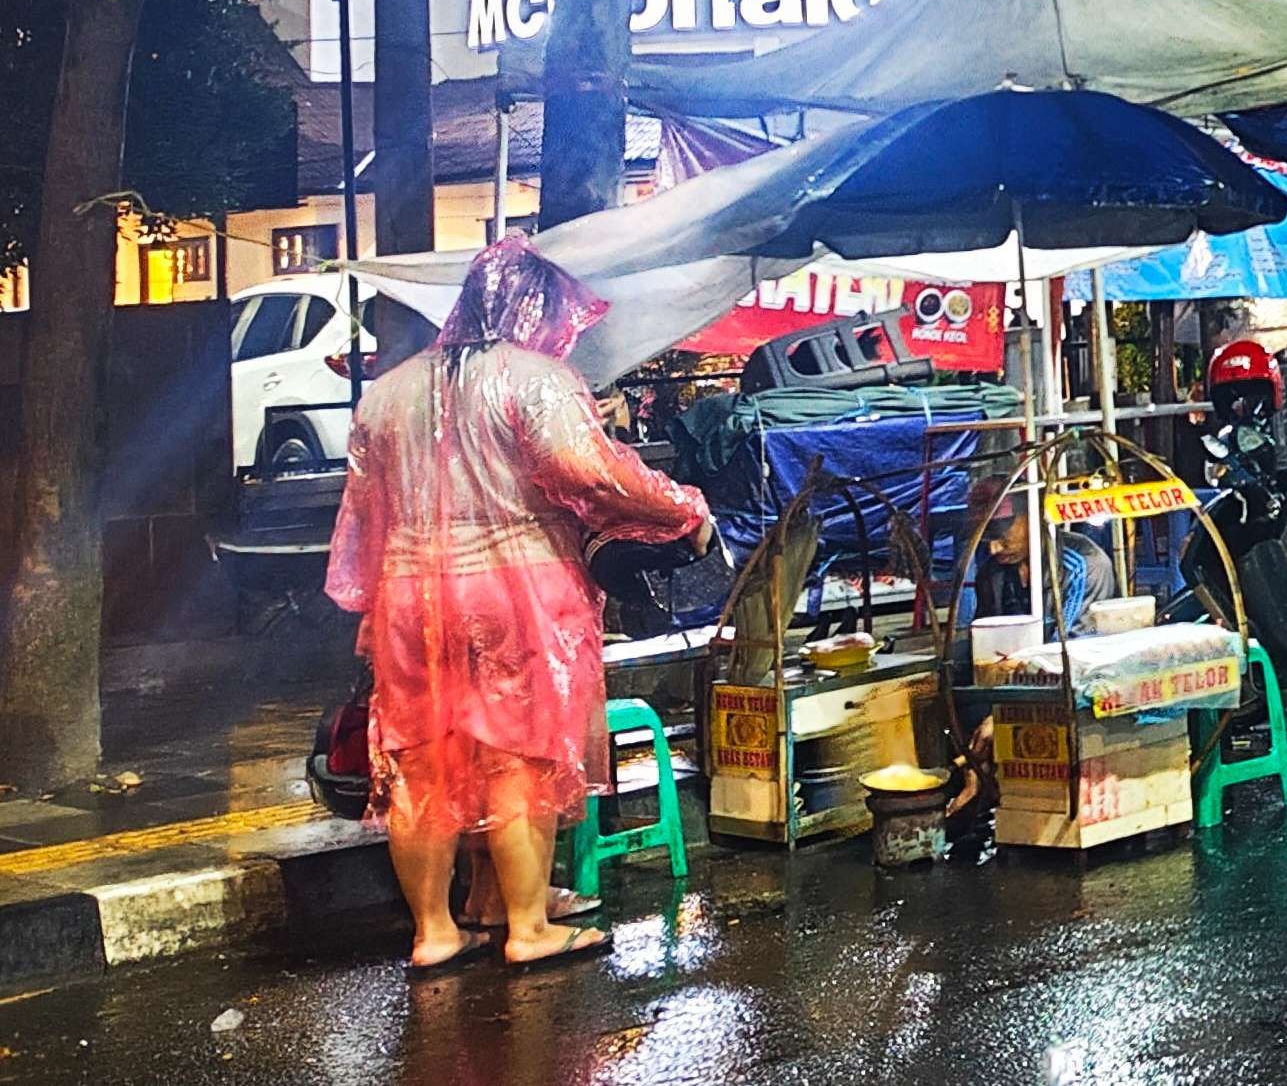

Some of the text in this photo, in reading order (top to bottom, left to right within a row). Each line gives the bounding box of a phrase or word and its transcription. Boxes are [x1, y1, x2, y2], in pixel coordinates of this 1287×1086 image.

[1056, 487, 1186, 521] KERAK TELOR
[1101, 665, 1229, 712] KEAK TELOR
